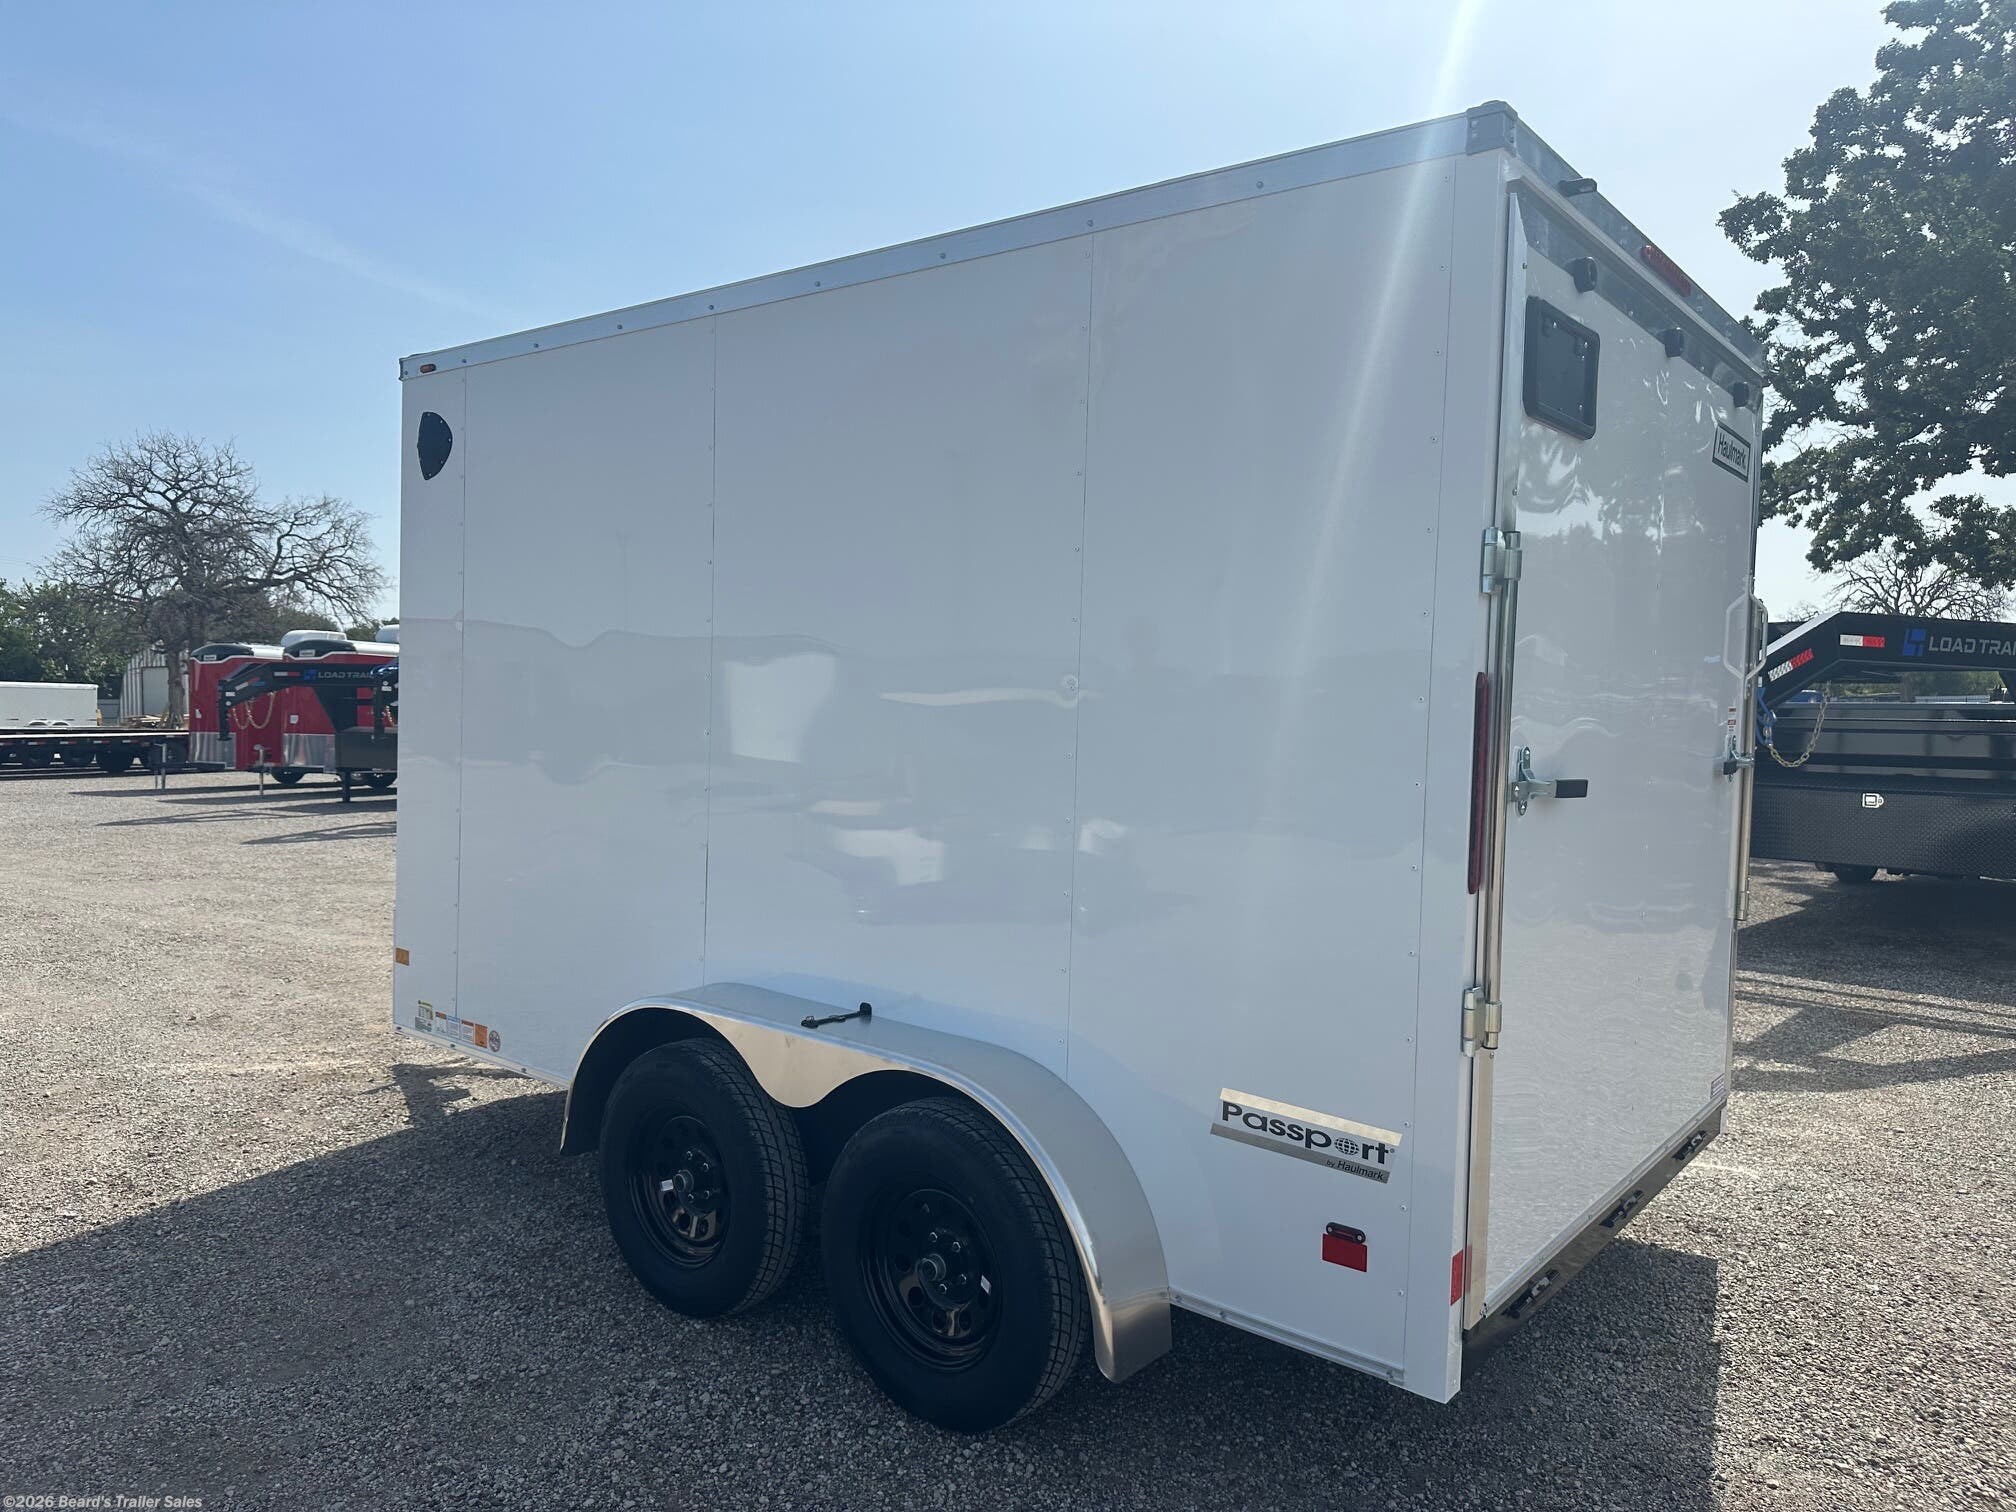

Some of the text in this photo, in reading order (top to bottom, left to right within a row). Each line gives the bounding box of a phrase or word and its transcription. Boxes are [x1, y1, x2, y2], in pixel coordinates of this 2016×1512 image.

[1717, 431, 1746, 470] Haulmark
[1326, 1159, 1383, 1181] by Haulmark
